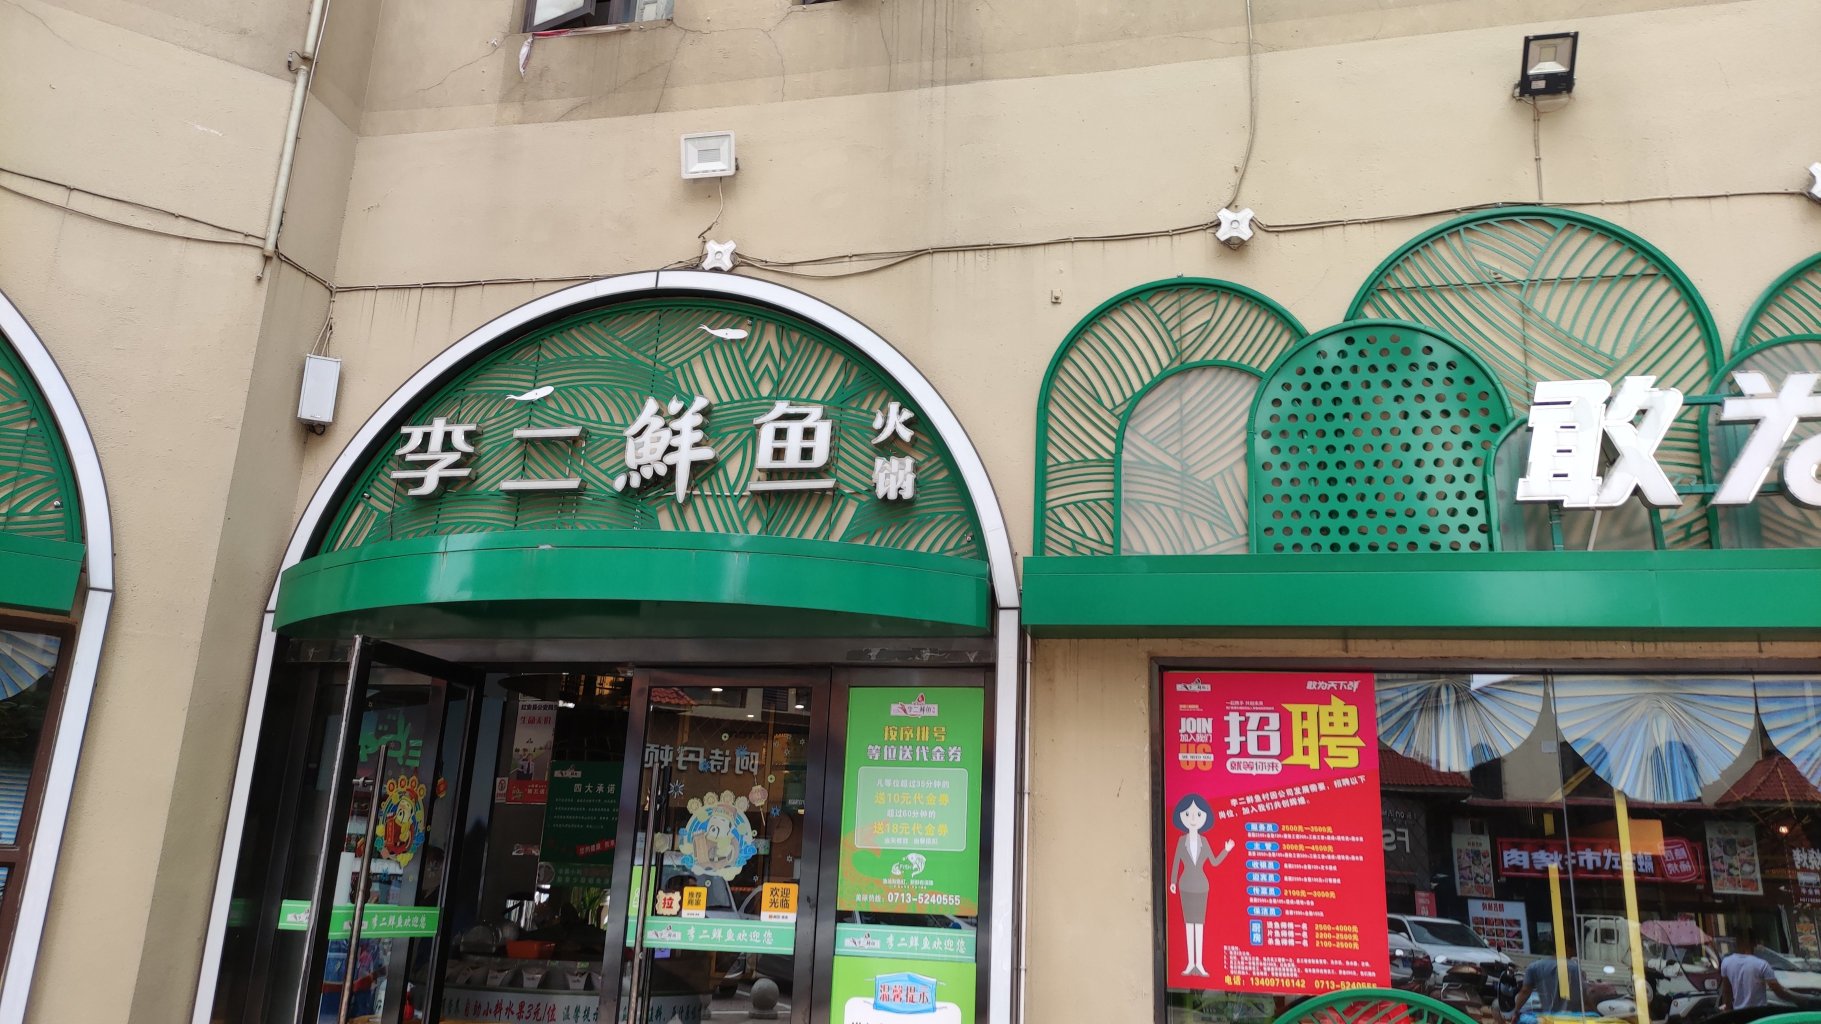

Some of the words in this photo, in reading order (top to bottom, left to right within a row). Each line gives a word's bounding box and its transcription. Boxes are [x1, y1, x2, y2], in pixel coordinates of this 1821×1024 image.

[871, 402, 918, 500] 火锅
[1179, 717, 1213, 734] JOIN
[1223, 694, 1367, 770] 招聘
[884, 726, 947, 742] 按序排号
[1180, 733, 1213, 743] 加入我们
[867, 745, 962, 762] 等位送代金券
[1250, 822, 1274, 832] 服务员
[769, 887, 791, 898] 欢迎
[888, 892, 961, 905] 0713-5240555
[661, 896, 674, 909] 拉
[768, 898, 790, 909] 光临
